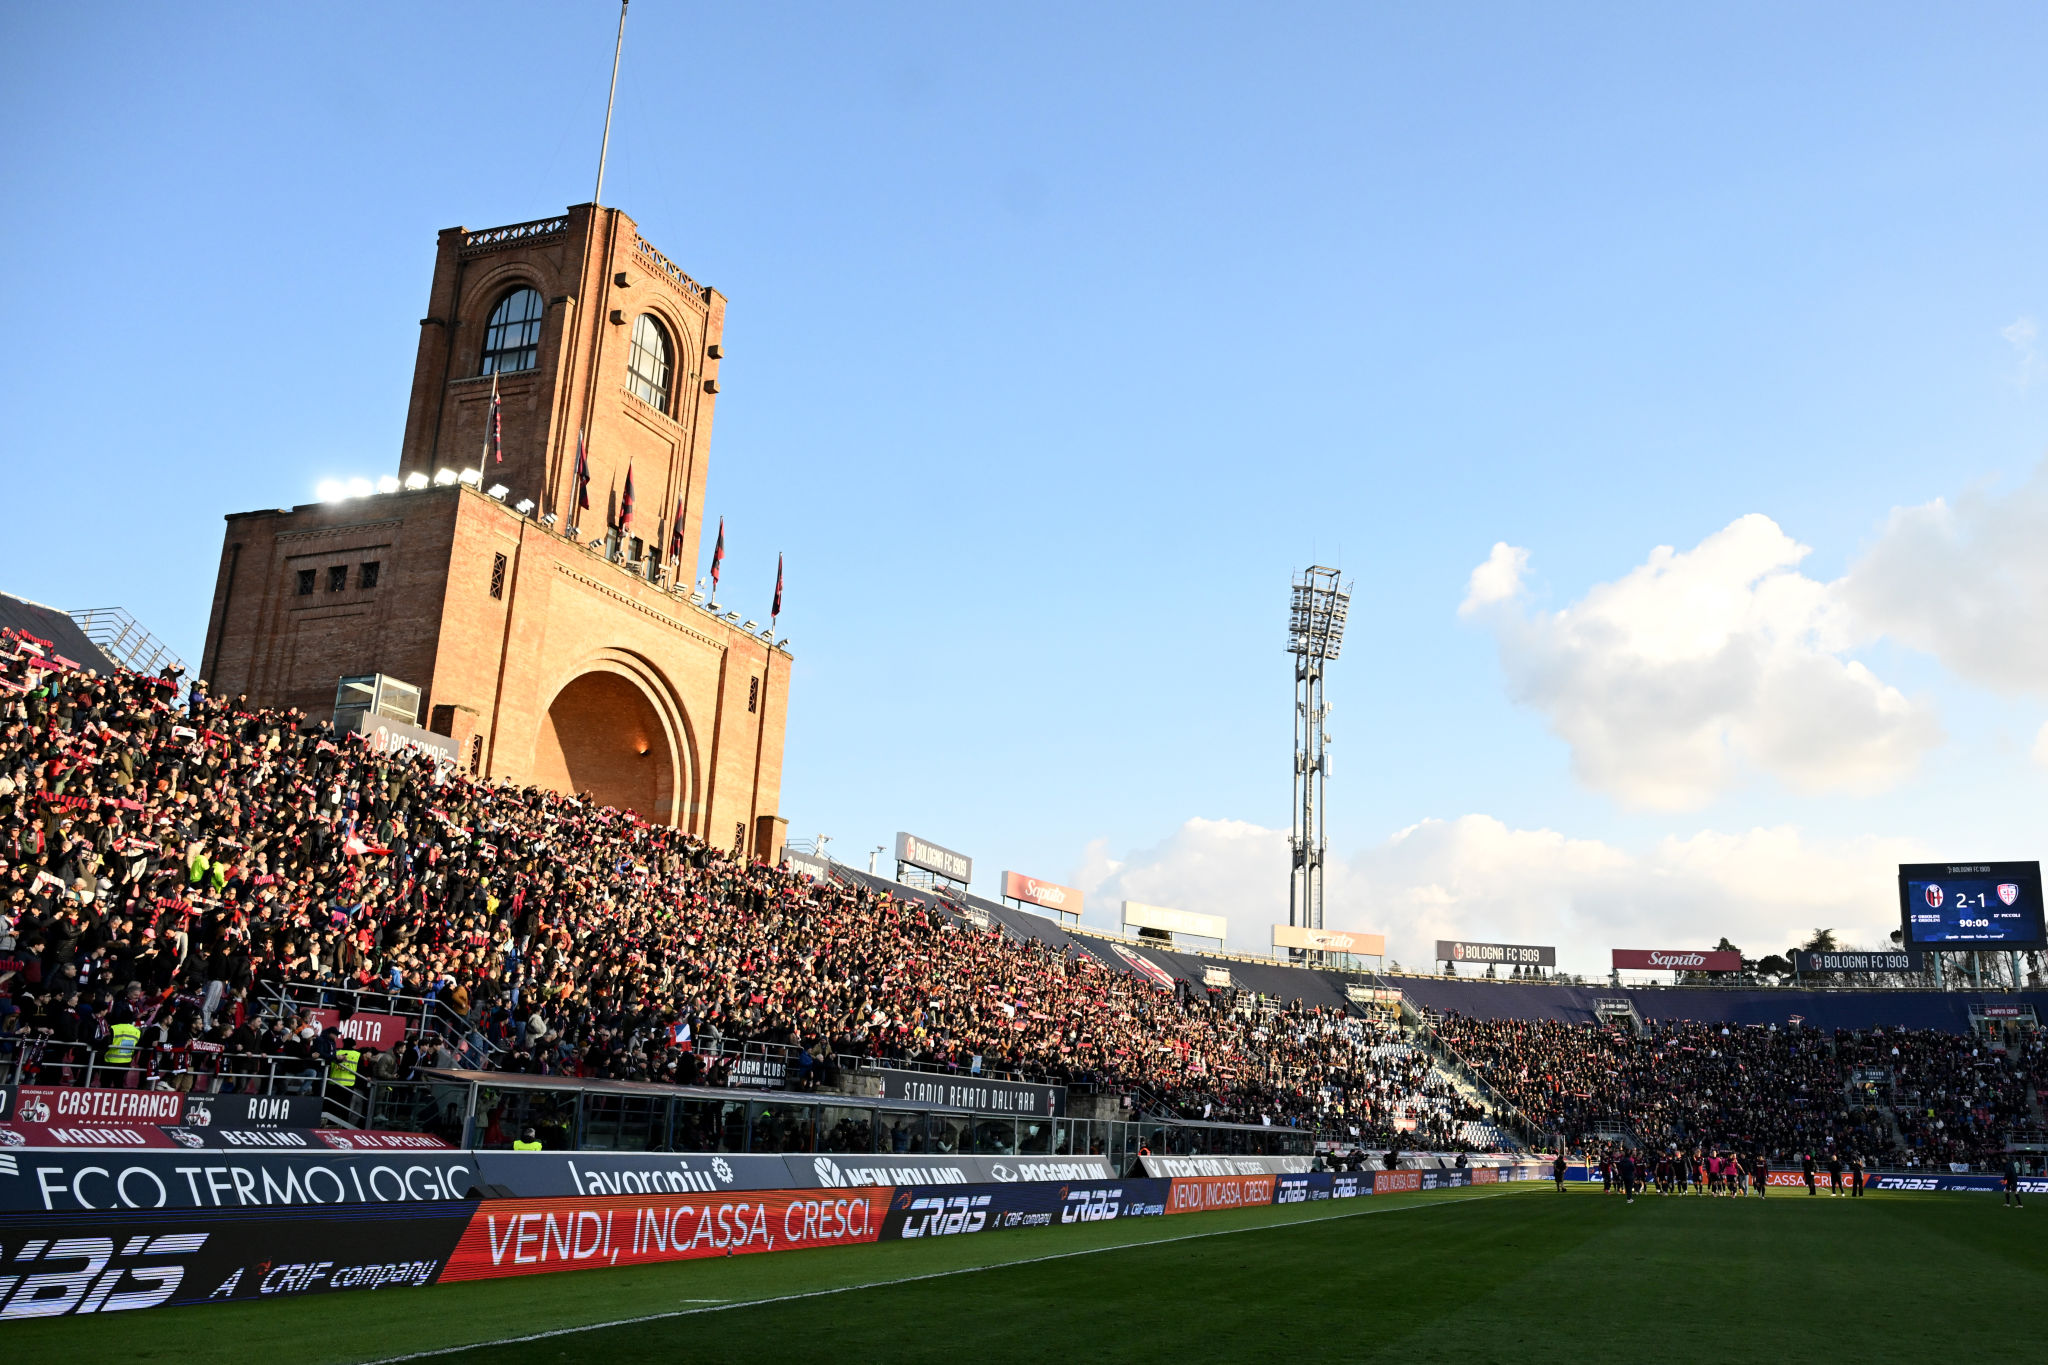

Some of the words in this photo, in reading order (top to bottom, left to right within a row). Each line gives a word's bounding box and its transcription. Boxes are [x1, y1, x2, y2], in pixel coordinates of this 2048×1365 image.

[915, 842, 944, 870] BOLOGNA
[945, 853, 953, 872] FC
[1025, 879, 1066, 904] Saputo
[1955, 893, 1987, 908] 2-1
[1959, 919, 1989, 928] 90:00
[1465, 945, 1503, 960] BOLOGNA
[1506, 948, 1518, 961] FC
[1520, 948, 1540, 962] 1909
[1647, 951, 1707, 969] Saputo
[1824, 955, 1868, 969] BOLOGNA
[1871, 955, 1883, 969] FC
[1885, 955, 1909, 969] 1909
[338, 1019, 382, 1042] MALTA
[763, 1062, 787, 1078] CLUBS
[57, 1090, 179, 1118] CASTELFRANCO
[904, 1081, 943, 1105] STADIO
[949, 1086, 986, 1109] RENATO
[991, 1089, 1035, 1112] DALL'ARA
[248, 1098, 290, 1120] ROMA
[47, 1127, 146, 1145] MADRID
[219, 1130, 308, 1147] BERLINO
[353, 1134, 381, 1147] GLI
[380, 1136, 447, 1148] SPECIALI
[845, 1168, 891, 1187] NEW
[1876, 1178, 1939, 1191] CRIBIS
[1173, 1184, 1204, 1211] VENDI,
[1205, 1182, 1243, 1206] INCASSA,
[1243, 1180, 1271, 1203] CRESCI.
[1061, 1189, 1122, 1224] CRIBIS
[1122, 1204, 1129, 1216] A
[902, 1195, 992, 1239] CRIBIS
[992, 1215, 1001, 1228] A
[1004, 1211, 1021, 1228] CRIF
[1022, 1211, 1053, 1227] company
[488, 1210, 619, 1265] VENDI,
[632, 1202, 775, 1255] INCASSA,
[783, 1198, 874, 1242] CRESCI.
[0, 1232, 211, 1321] IBIS
[209, 1266, 245, 1298] A
[259, 1260, 335, 1294] CRIF
[329, 1259, 439, 1290] company
